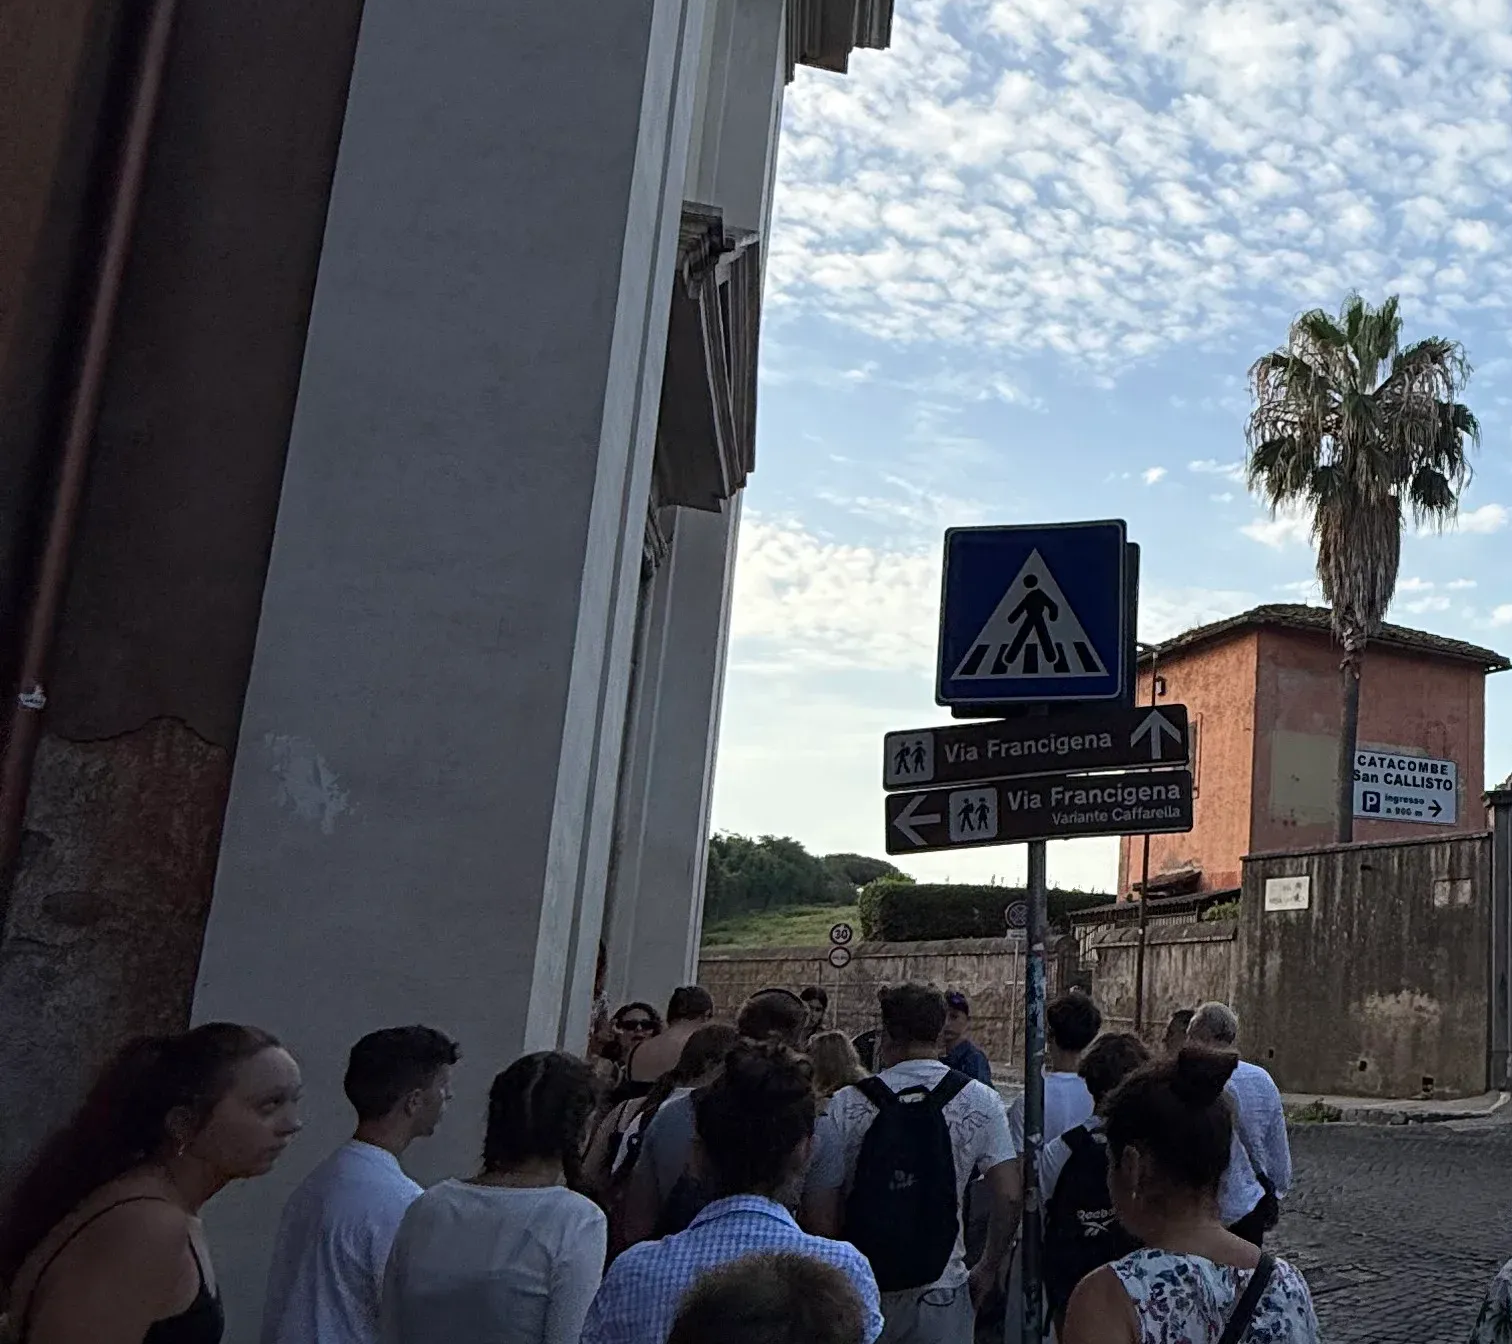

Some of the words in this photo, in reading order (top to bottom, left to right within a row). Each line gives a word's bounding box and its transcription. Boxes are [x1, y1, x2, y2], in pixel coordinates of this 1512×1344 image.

[944, 743, 979, 763] Via
[986, 731, 1113, 758] Francigena
[1357, 754, 1449, 776] CATACOMBE
[1353, 768, 1380, 784] San
[1383, 772, 1453, 791] CALLISTO
[1007, 790, 1043, 811] Via
[1050, 782, 1181, 807] Francigena
[1051, 809, 1108, 826] Variante
[1111, 805, 1181, 822] Caffarella
[835, 929, 848, 940] 30
[1077, 1208, 1117, 1221] Reebo
